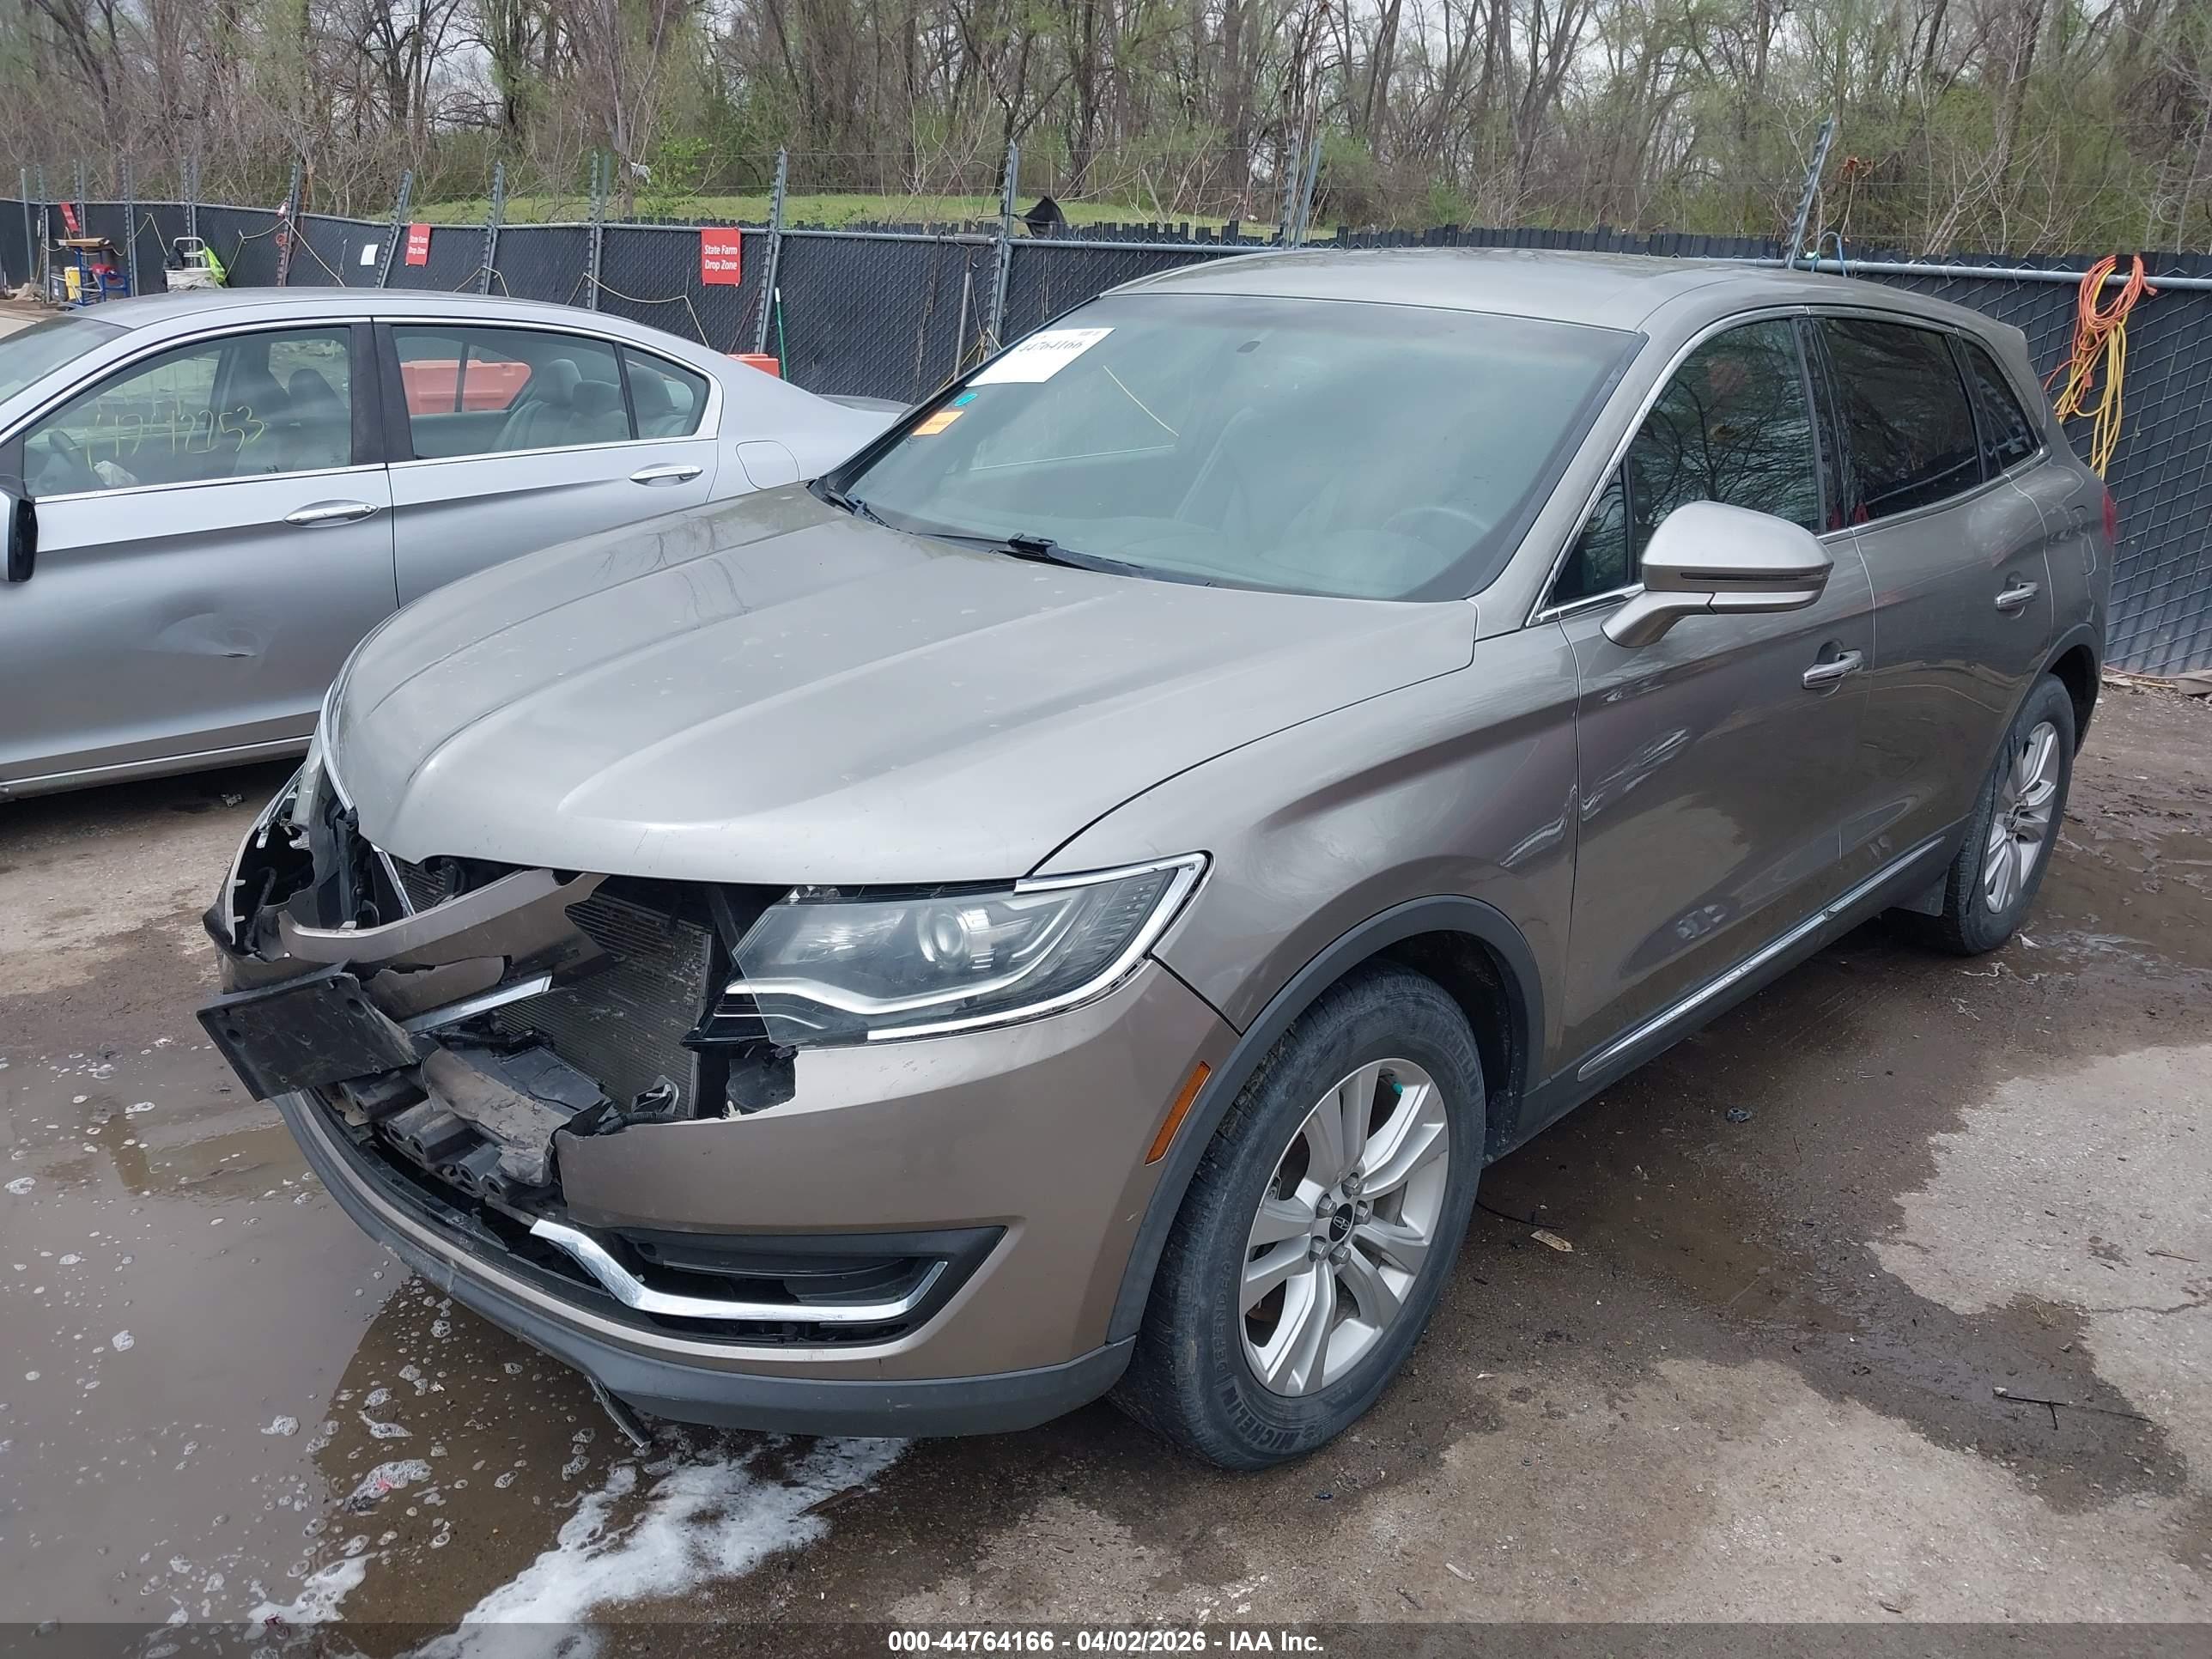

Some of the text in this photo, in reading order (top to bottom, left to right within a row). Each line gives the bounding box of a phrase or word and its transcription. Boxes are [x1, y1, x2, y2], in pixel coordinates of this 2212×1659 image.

[704, 245, 738, 255] State Farm
[704, 259, 738, 272] Drop Zone
[1218, 1383, 1302, 1451] MICHELIN
